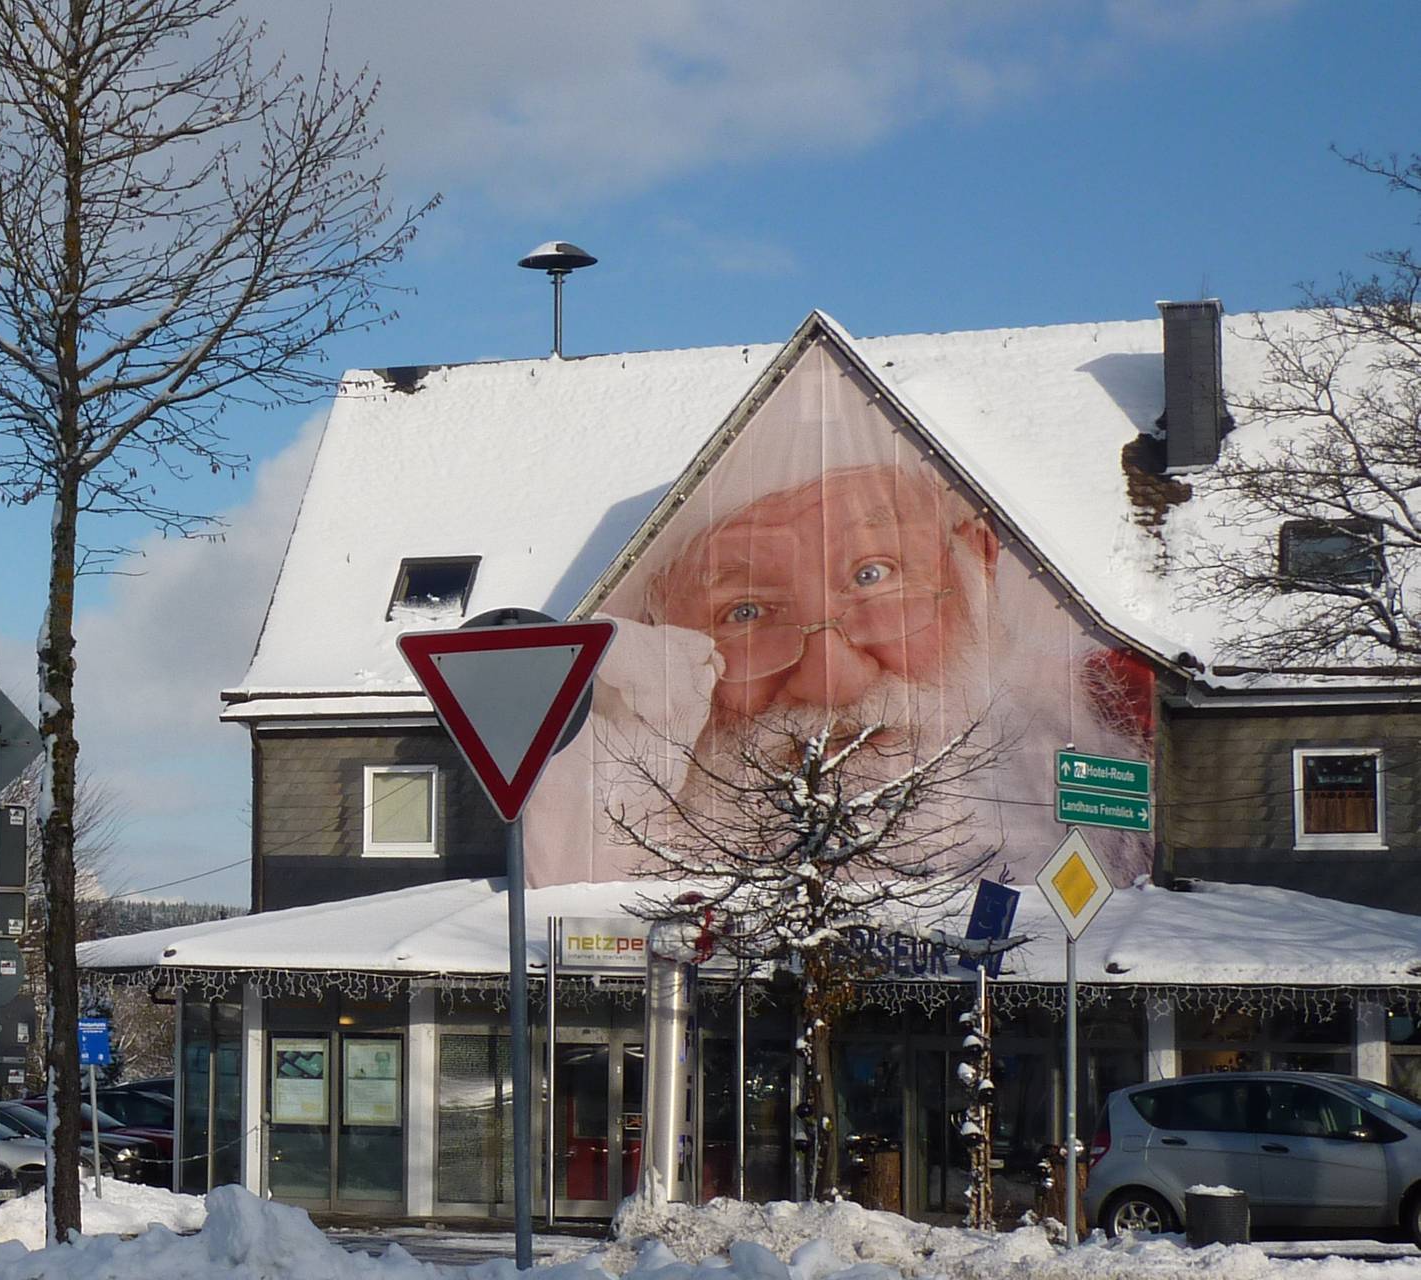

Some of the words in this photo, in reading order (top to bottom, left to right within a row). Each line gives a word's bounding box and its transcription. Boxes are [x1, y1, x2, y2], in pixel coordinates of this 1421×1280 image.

[1087, 764, 1135, 782] Hotel-Route
[1062, 799, 1098, 814] Landhaus
[1099, 803, 1134, 818] Fernblick
[568, 934, 649, 954] netzpe
